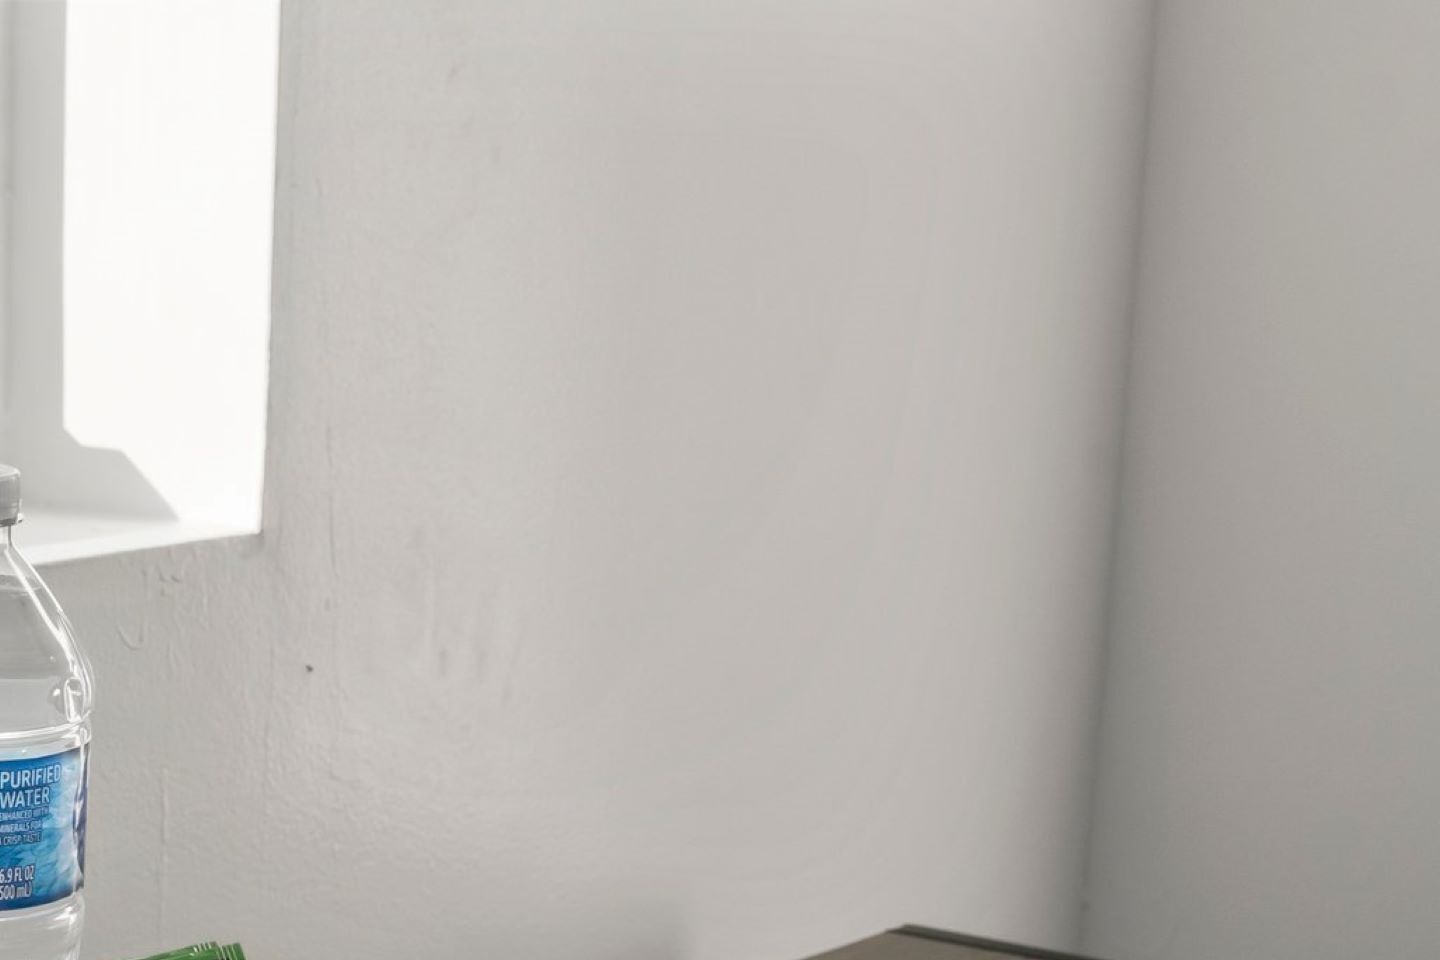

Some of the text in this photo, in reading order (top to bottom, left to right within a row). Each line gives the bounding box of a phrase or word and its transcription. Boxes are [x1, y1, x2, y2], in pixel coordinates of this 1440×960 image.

[0, 764, 61, 790] PURIFIED
[0, 787, 50, 809] WATER
[14, 867, 23, 882] FL
[24, 864, 34, 880] OZ
